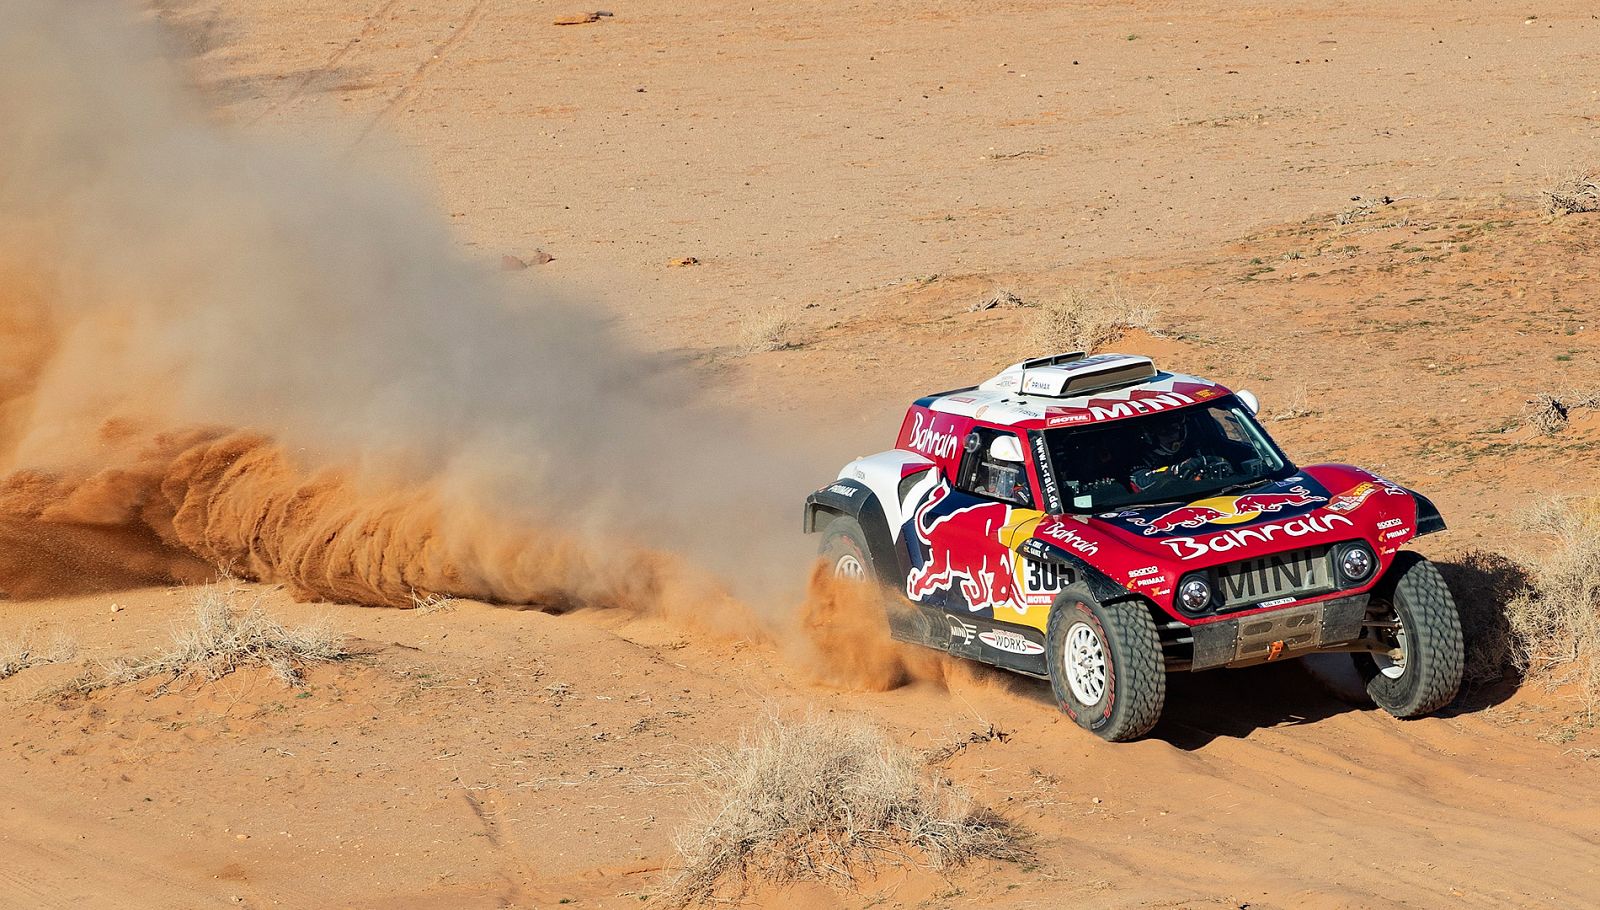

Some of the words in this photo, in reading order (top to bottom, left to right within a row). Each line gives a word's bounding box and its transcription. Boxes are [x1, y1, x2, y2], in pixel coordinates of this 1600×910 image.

[1088, 391, 1196, 421] MINI
[1050, 415, 1088, 425] MOTUL
[908, 411, 958, 460] Bahrain
[1035, 436, 1059, 509] www.x-raid.de
[827, 484, 859, 498] PRIMAX
[1376, 517, 1403, 530] sparco
[1042, 521, 1099, 557] Bahrain
[1159, 513, 1354, 561] Bahrain
[1386, 527, 1411, 539] PRIMAX
[1027, 558, 1075, 592] 305
[1127, 565, 1159, 578] sparco
[1218, 549, 1316, 600] MINI
[1137, 575, 1166, 587] PRIMAX
[1027, 595, 1052, 604] MOTUL
[951, 625, 967, 638] MINI
[994, 634, 1027, 652] WORKS
